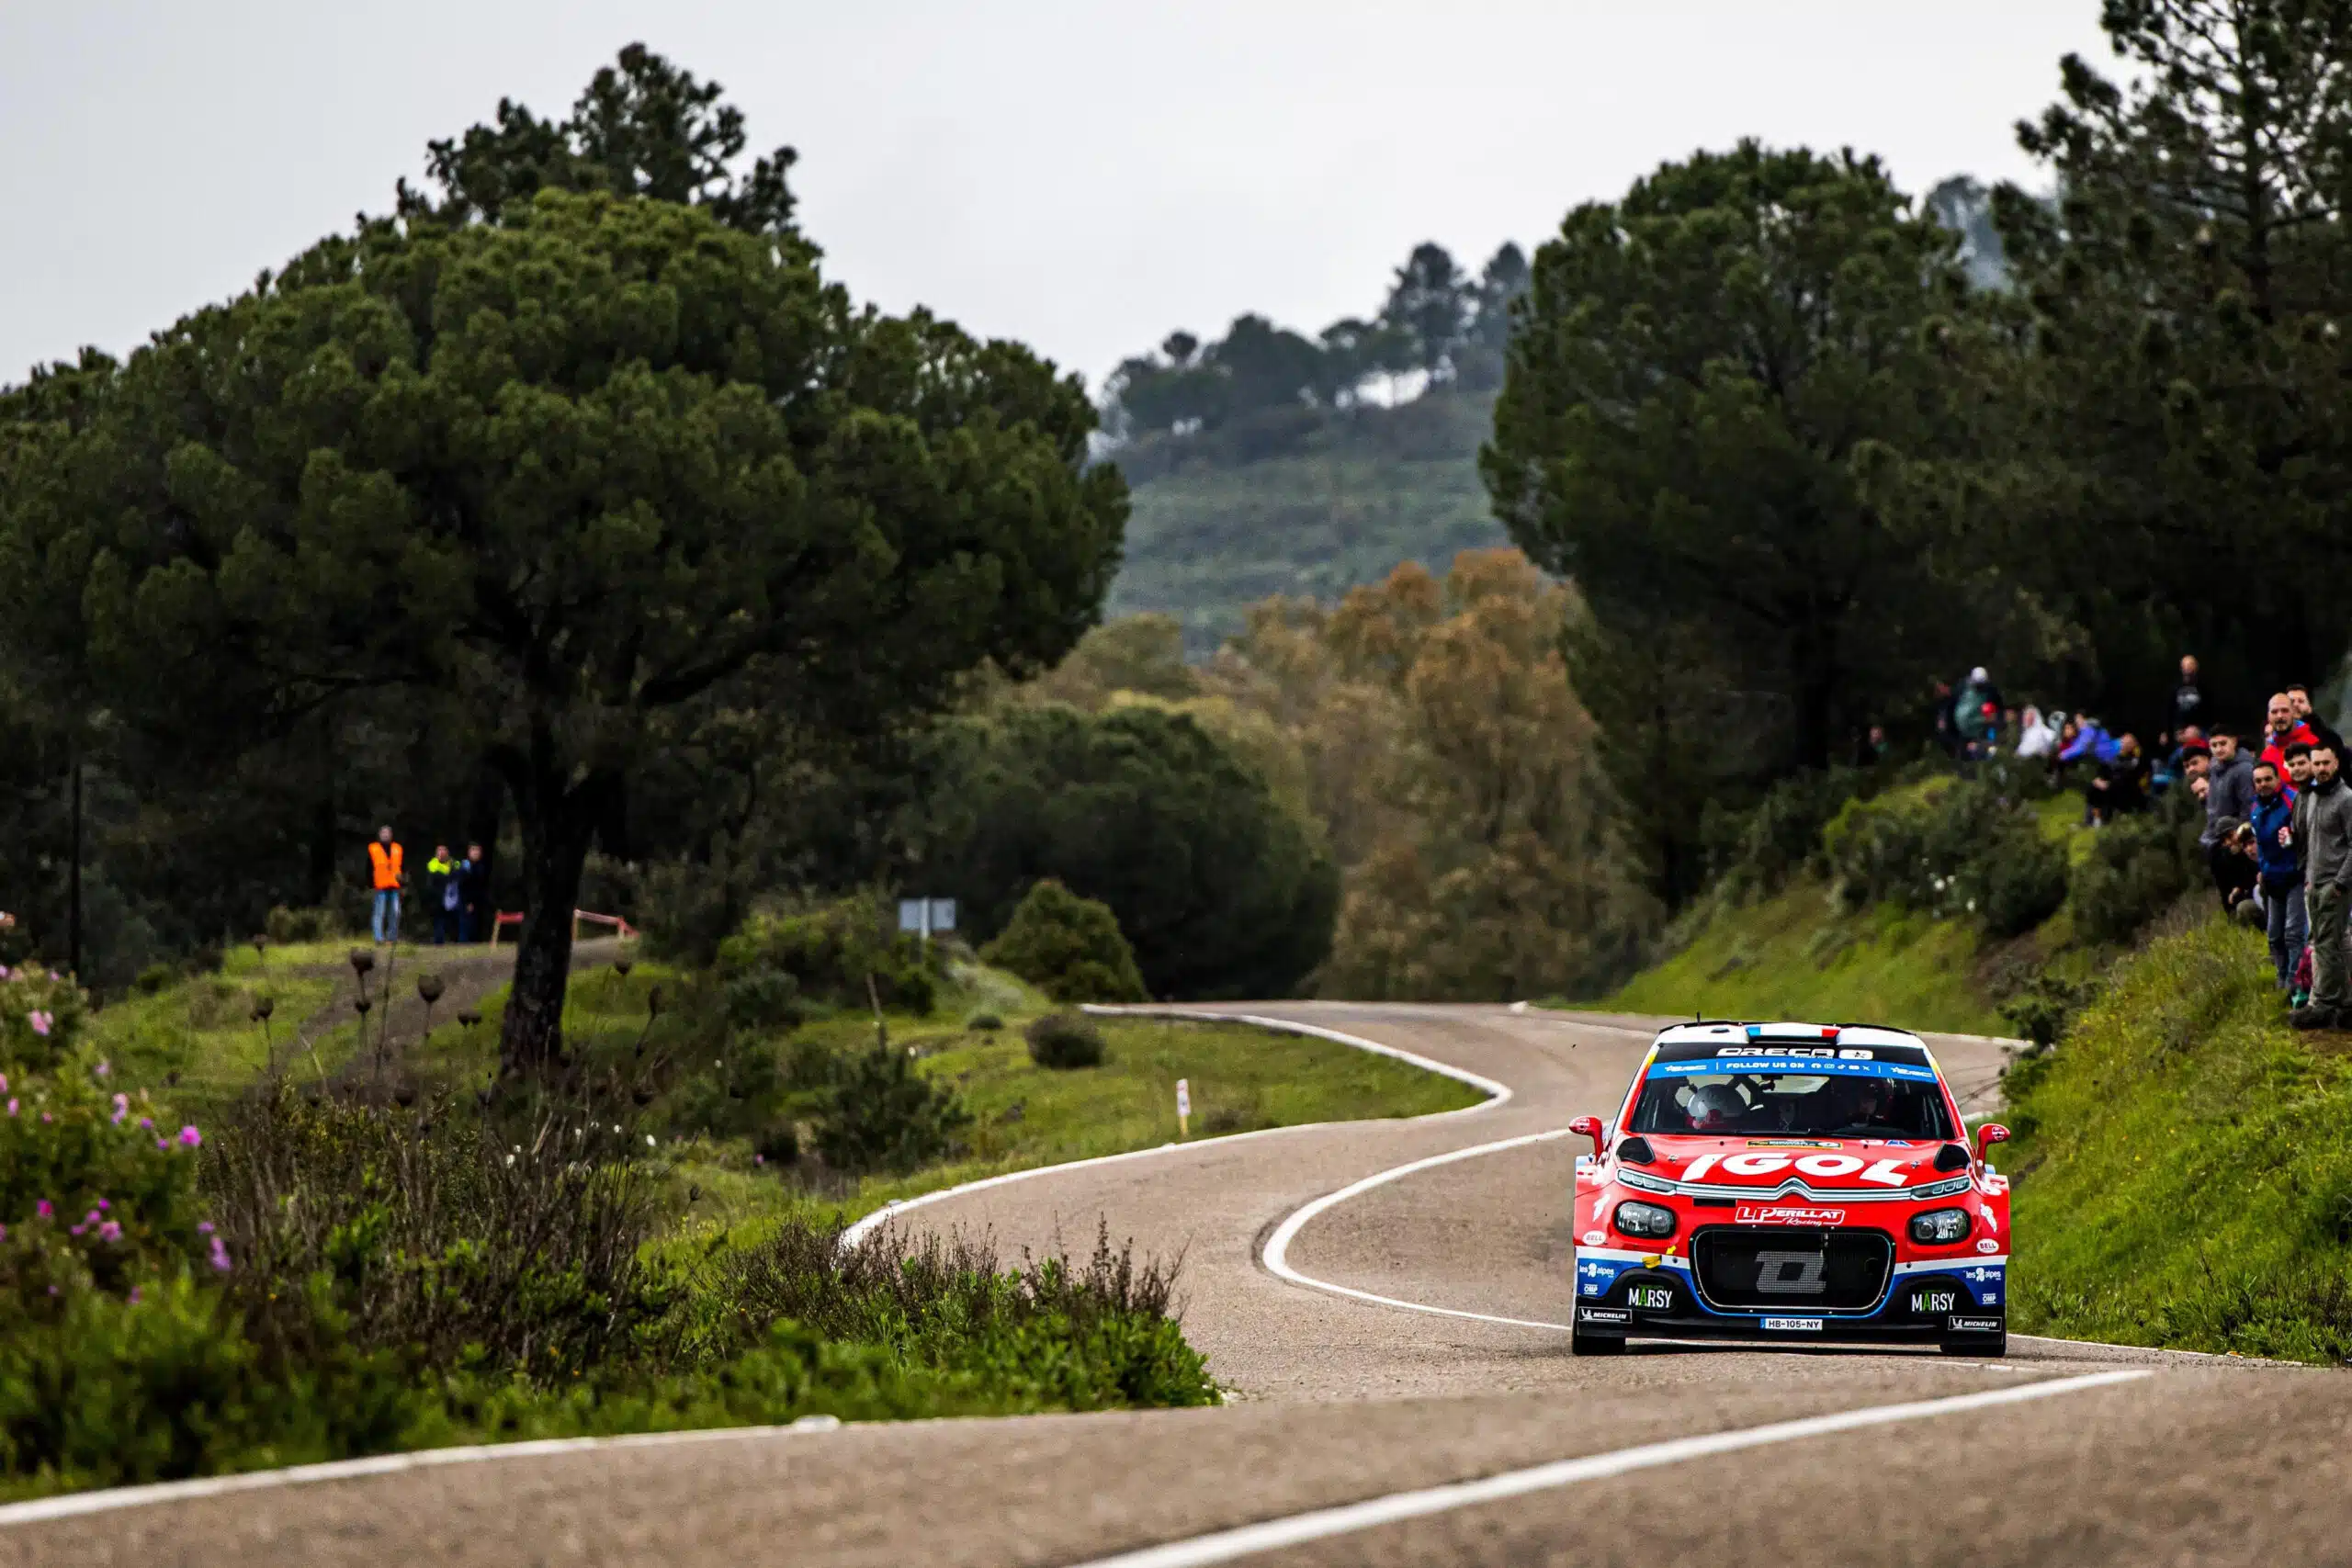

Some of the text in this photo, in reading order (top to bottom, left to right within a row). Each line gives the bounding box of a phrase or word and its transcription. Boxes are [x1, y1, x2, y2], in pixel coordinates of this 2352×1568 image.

[1679, 1152, 1908, 1187] IGOL
[1785, 1218, 1823, 1226] Racing
[1966, 1270, 1976, 1279] les
[1984, 1270, 2001, 1279] alpes
[1628, 1288, 1672, 1308] MARSY
[1911, 1293, 1955, 1312] MARSY
[1593, 1312, 1627, 1320] MICHELIN
[1768, 1320, 1820, 1329] HB-105-NY
[1963, 1320, 1997, 1328] MICHELIN
